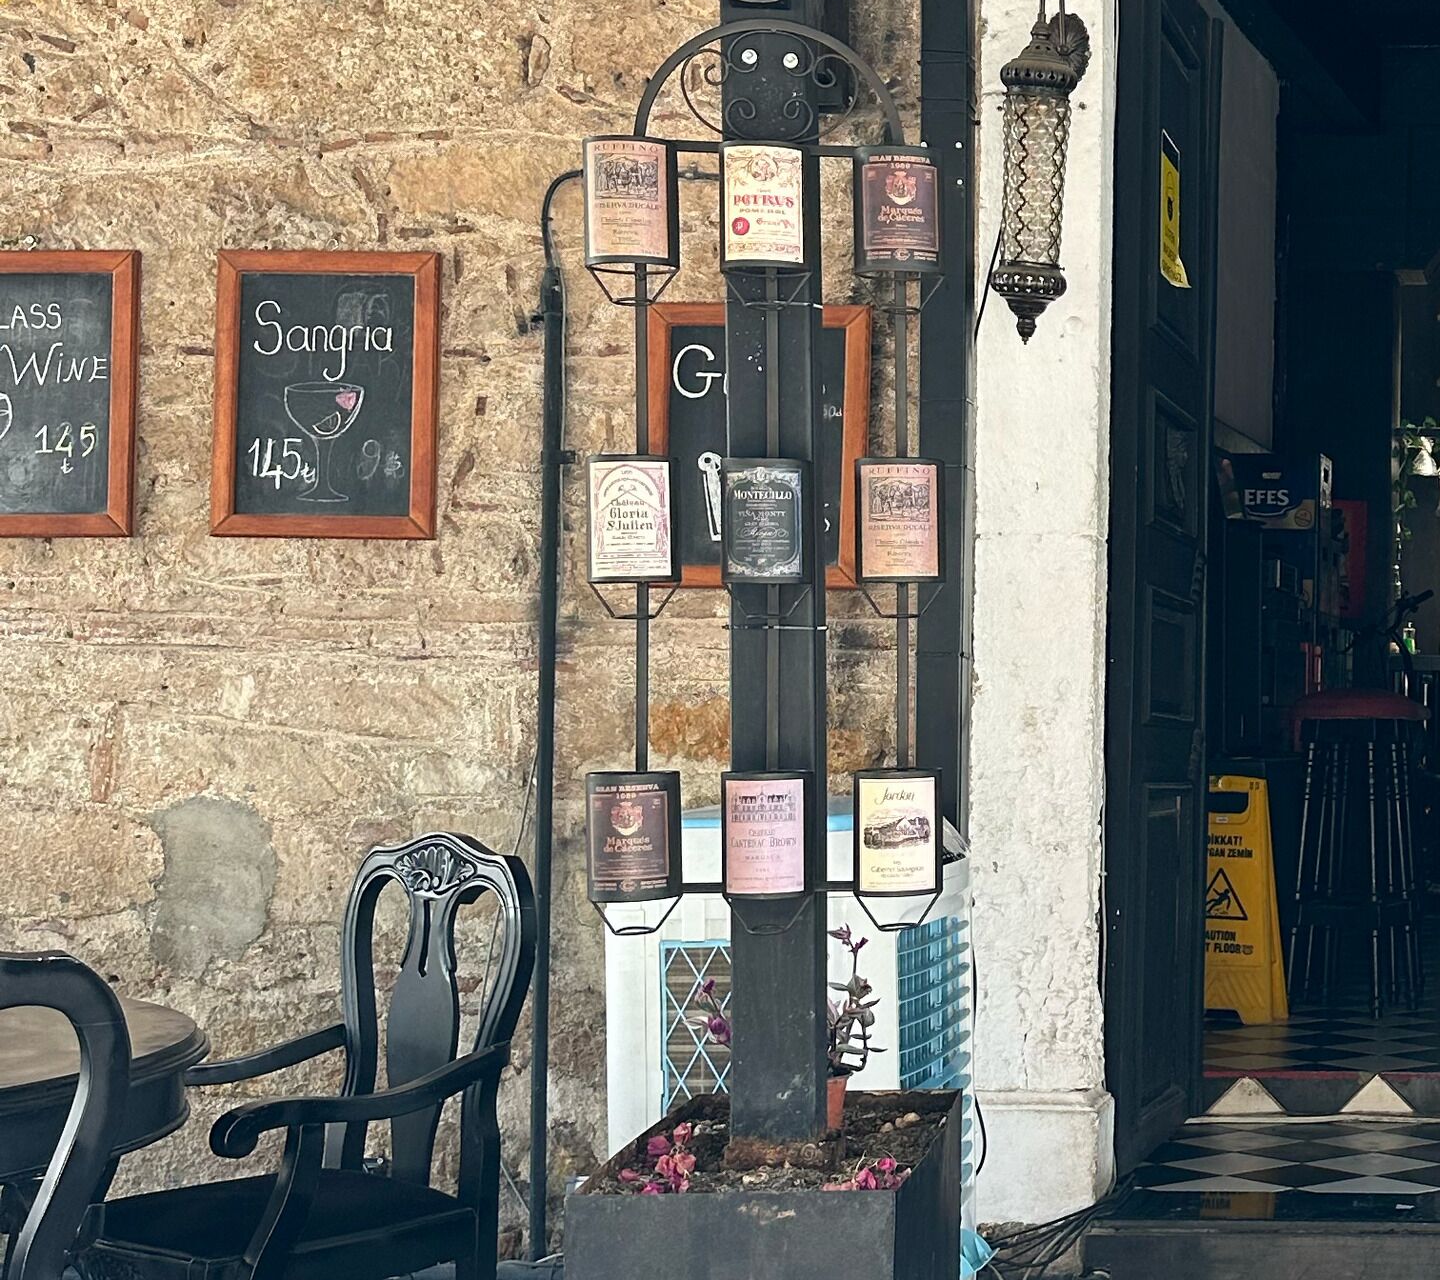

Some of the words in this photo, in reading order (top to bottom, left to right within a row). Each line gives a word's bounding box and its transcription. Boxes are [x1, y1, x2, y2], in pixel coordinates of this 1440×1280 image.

[733, 194, 794, 208] PETRUS
[253, 299, 393, 381] Sangria
[733, 489, 793, 500] MONTECILLO
[1244, 488, 1290, 507] EFES
[609, 507, 649, 519] Gloria
[874, 786, 915, 805] Jordan
[1205, 929, 1236, 941] AUTION
